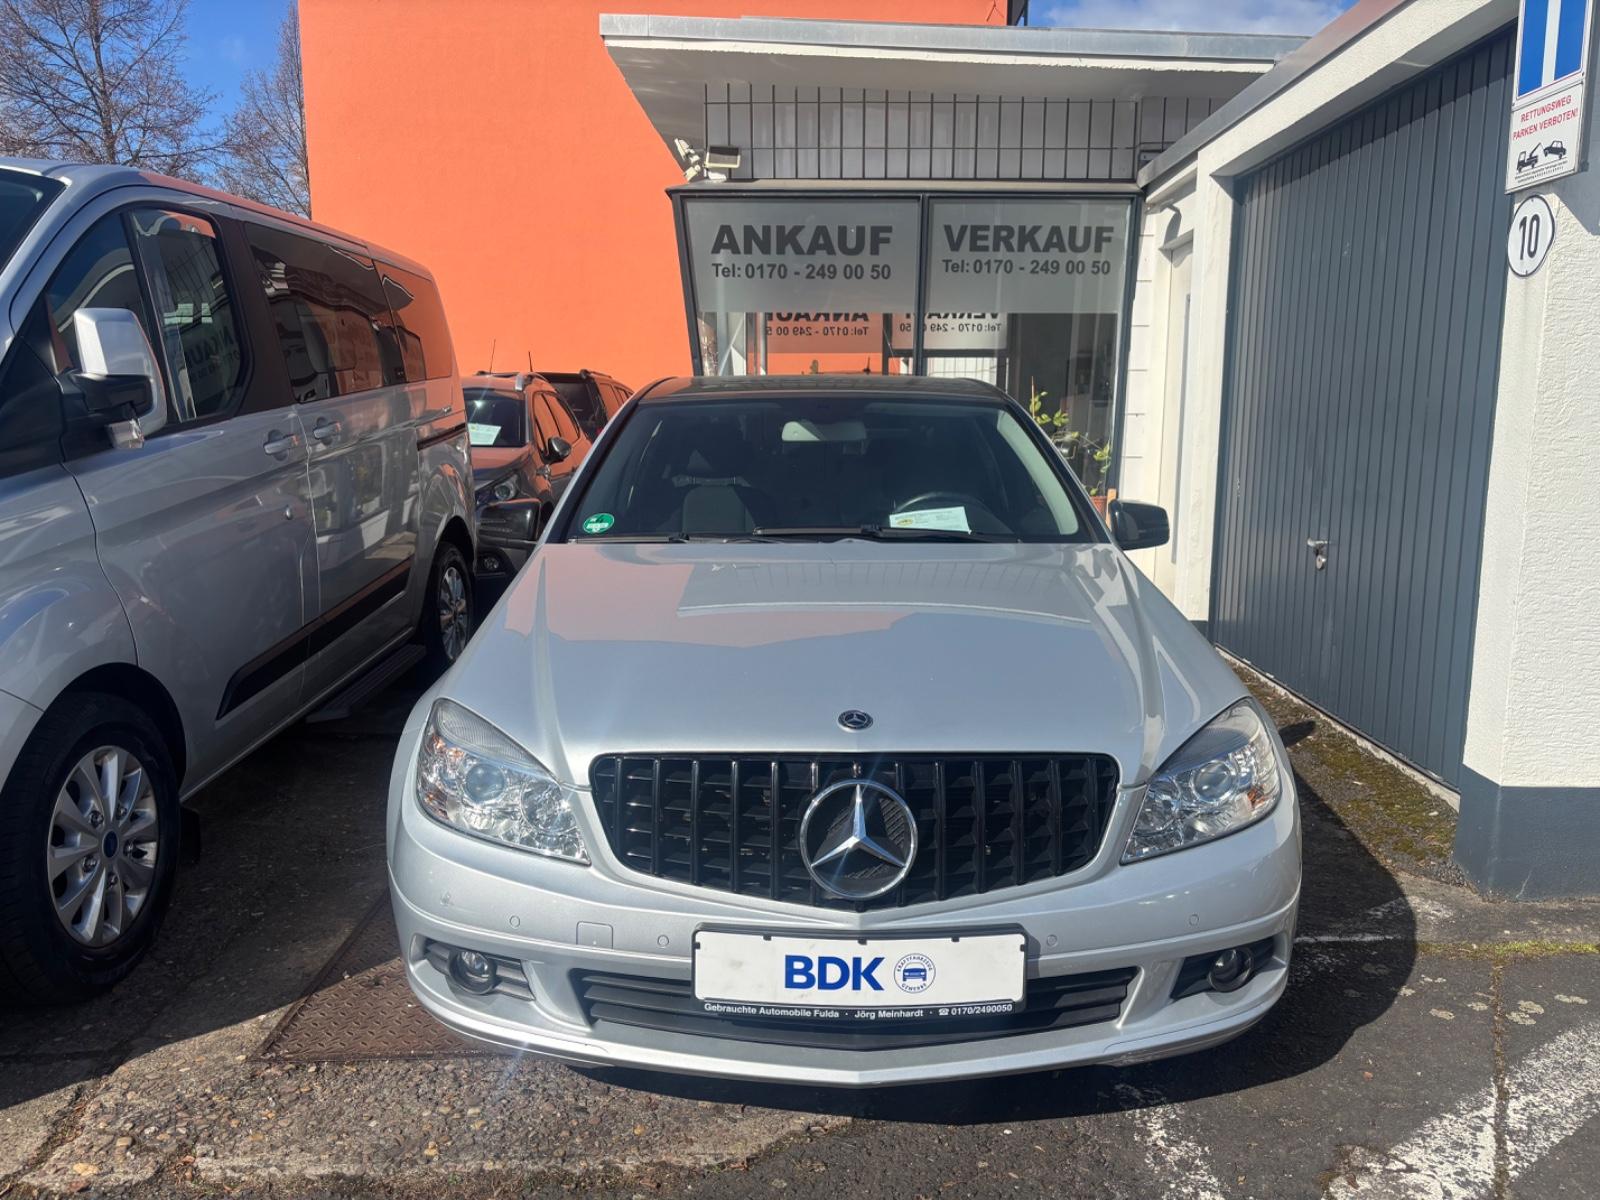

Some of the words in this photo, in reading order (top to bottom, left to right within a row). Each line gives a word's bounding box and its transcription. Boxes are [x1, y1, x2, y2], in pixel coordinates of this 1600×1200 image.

[1521, 95, 1572, 122] RETTUNGSWEG
[1513, 124, 1538, 140] PARKEN
[1539, 108, 1578, 131] VERBOTEN!
[711, 224, 893, 256] ANKAUF
[943, 224, 1115, 254] VERKAUF
[1519, 213, 1541, 260] 10
[711, 263, 741, 279] Tel:
[744, 263, 788, 279] 0170
[805, 263, 838, 280] 249
[843, 264, 865, 280] 00
[870, 264, 892, 280] 50
[942, 259, 970, 274] Tel:
[973, 259, 1014, 275] 0170
[1029, 259, 1060, 275] 249
[1065, 260, 1086, 276] 00
[1091, 260, 1111, 276] 50
[784, 954, 885, 992] BDK
[704, 1003, 757, 1015] Gebrauchte
[759, 1006, 812, 1017] Automobile
[813, 1008, 840, 1018] Fulda
[854, 1009, 876, 1020] Jörg
[878, 1009, 924, 1019] Meinhardt
[951, 1003, 1013, 1016] 0170/2490050
